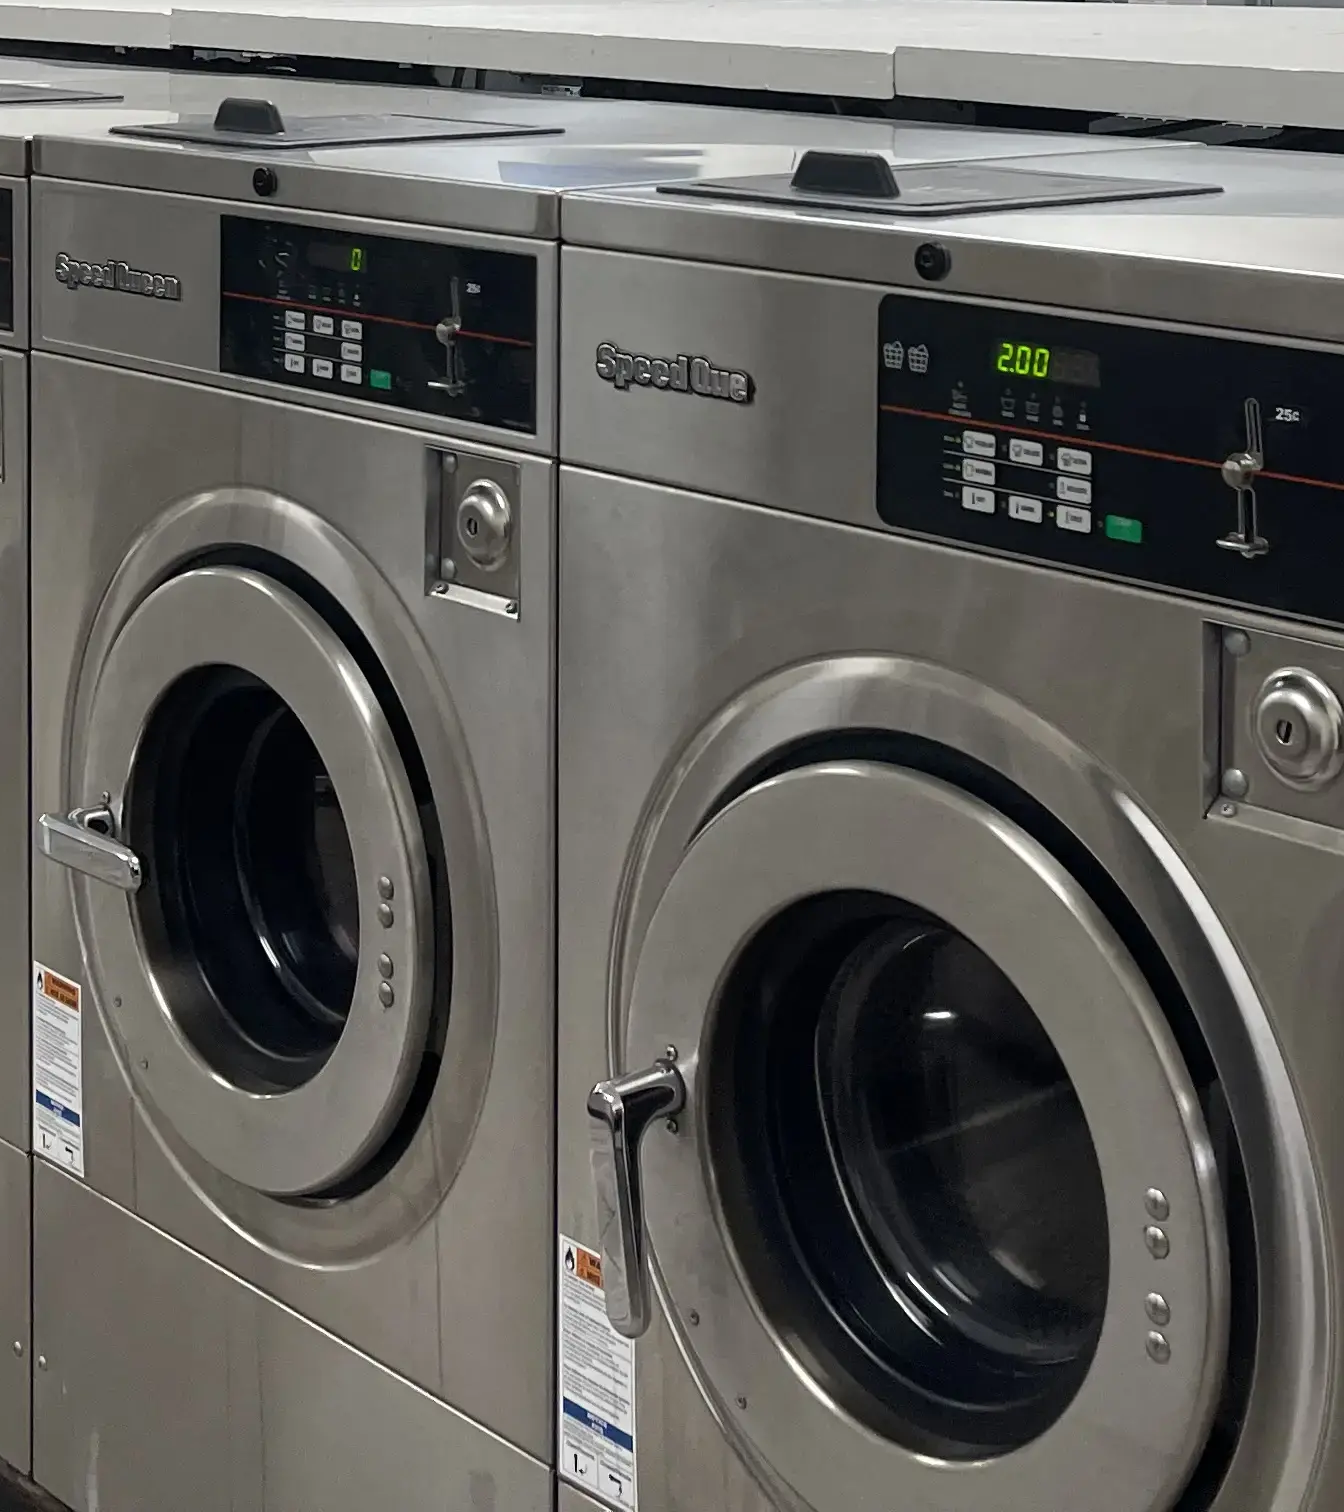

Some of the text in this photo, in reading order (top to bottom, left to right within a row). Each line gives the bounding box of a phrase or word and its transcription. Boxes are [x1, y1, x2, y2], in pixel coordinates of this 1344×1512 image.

[55, 252, 180, 301] Speed Queen
[351, 248, 361, 271] 0
[596, 343, 688, 390] Speed
[997, 343, 1050, 377] 2.00
